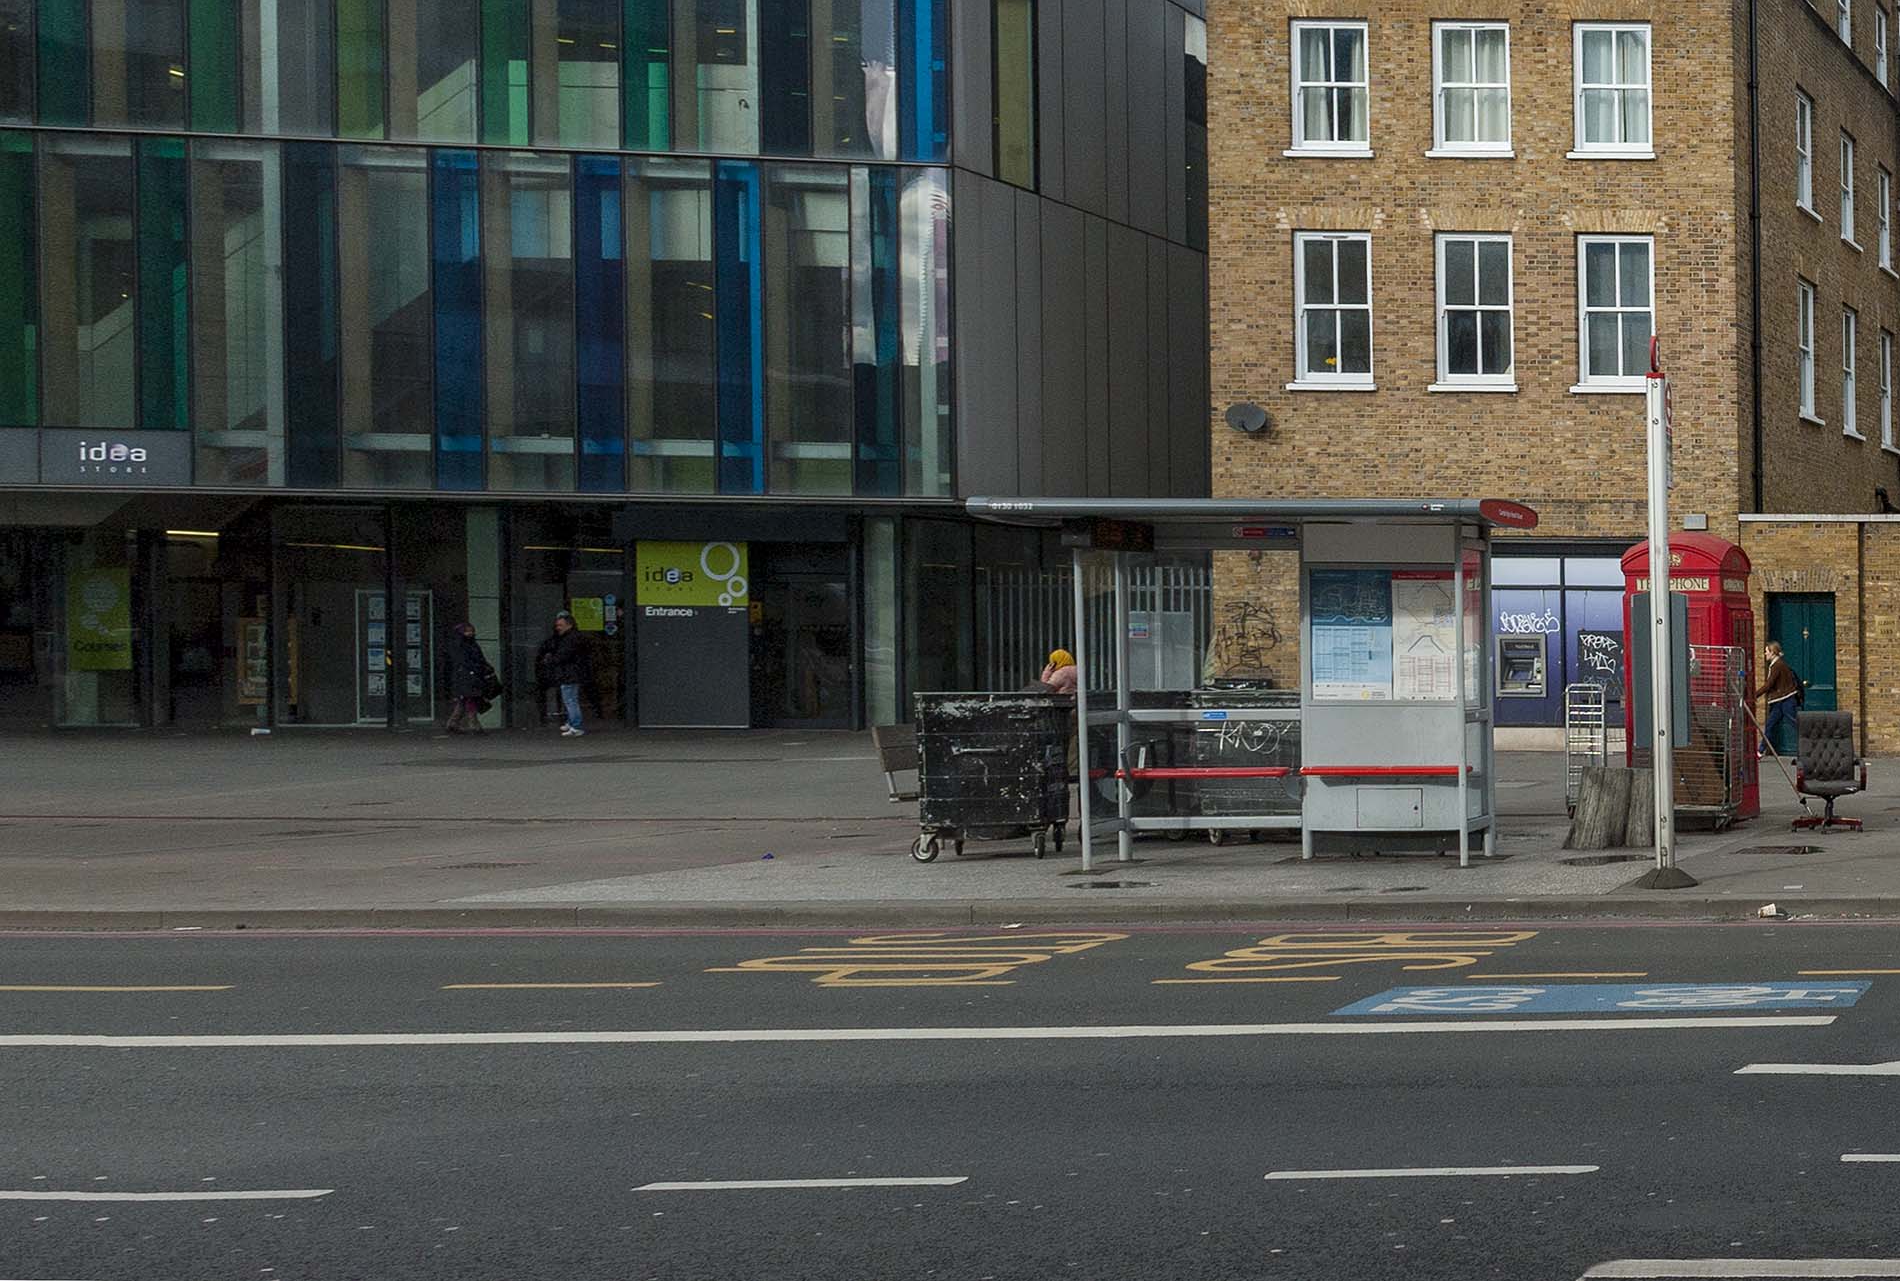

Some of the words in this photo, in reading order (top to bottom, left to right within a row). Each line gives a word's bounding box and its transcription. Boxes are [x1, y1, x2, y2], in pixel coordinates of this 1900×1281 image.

[79, 441, 146, 462] idea
[645, 567, 694, 585] idea
[645, 606, 693, 617] Entrance
